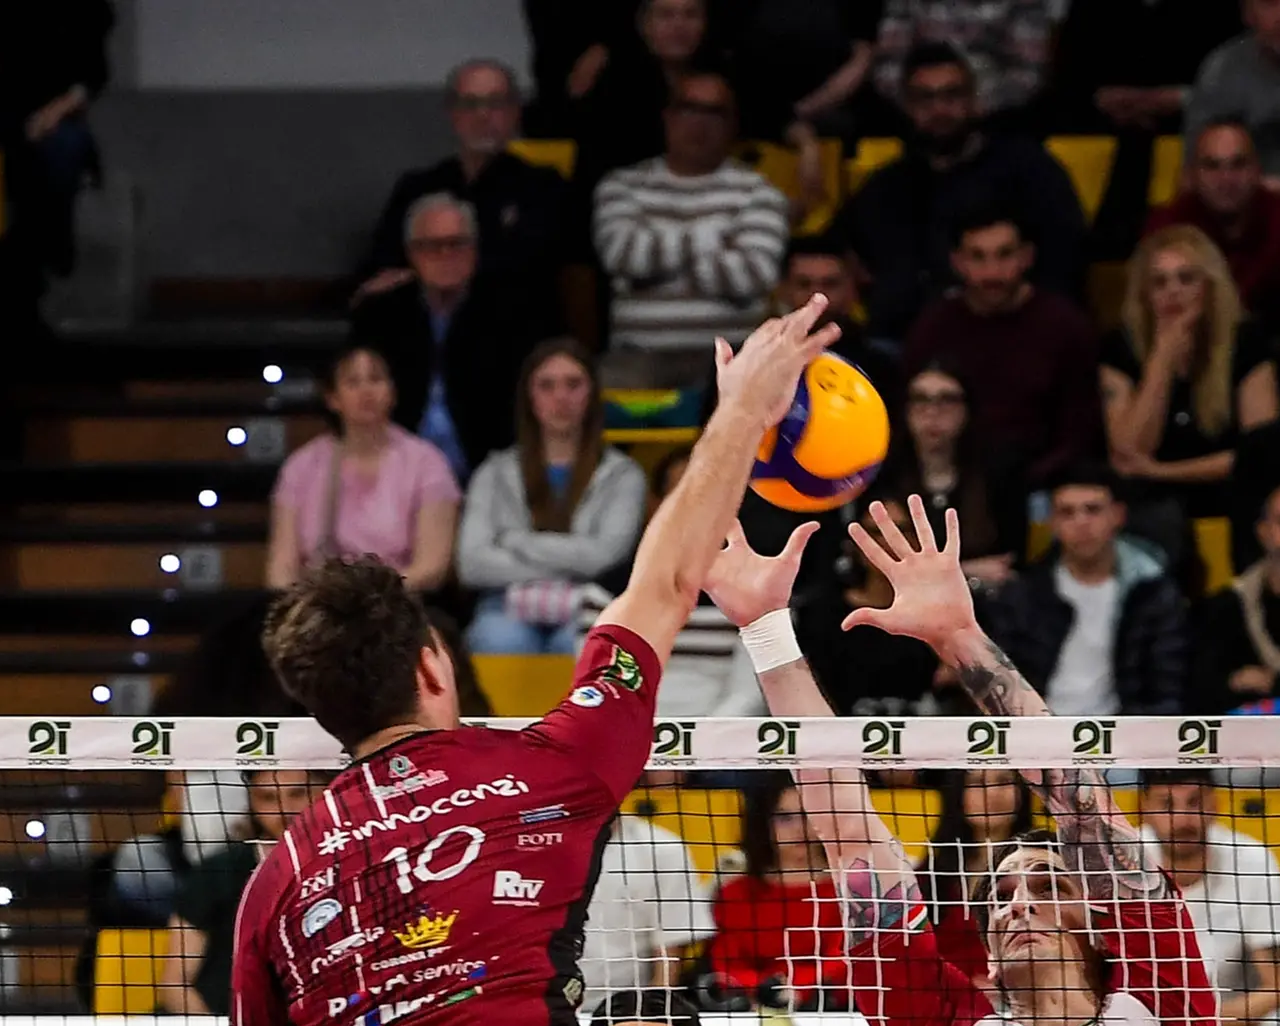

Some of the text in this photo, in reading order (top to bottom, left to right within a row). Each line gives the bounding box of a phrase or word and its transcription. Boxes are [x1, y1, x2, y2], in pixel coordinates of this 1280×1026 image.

[318, 775, 529, 855] #innocenzi
[518, 832, 563, 846] FOTI
[383, 825, 485, 894] 10
